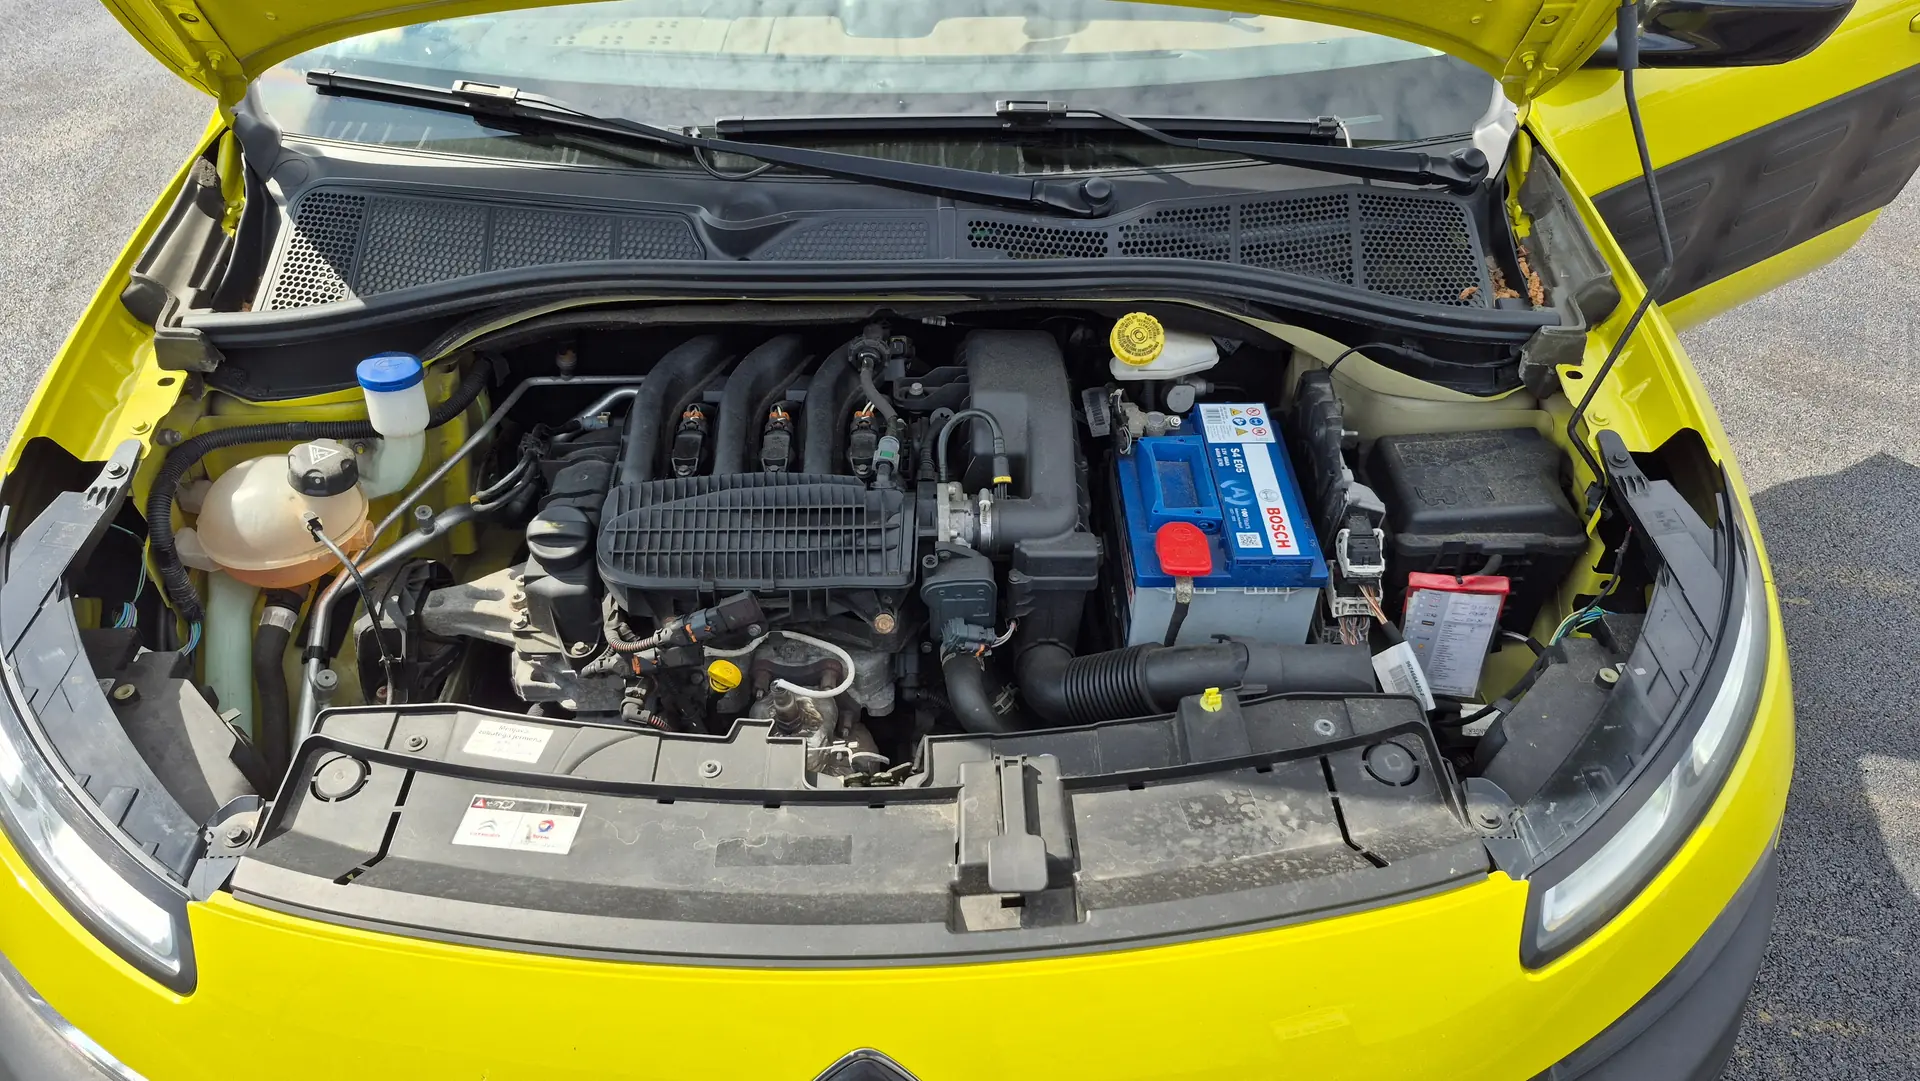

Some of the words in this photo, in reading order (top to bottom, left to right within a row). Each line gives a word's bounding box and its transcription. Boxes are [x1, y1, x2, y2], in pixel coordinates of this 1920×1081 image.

[1231, 448, 1241, 457] S4
[1233, 459, 1245, 473] E05
[1266, 507, 1291, 548] BOSCH
